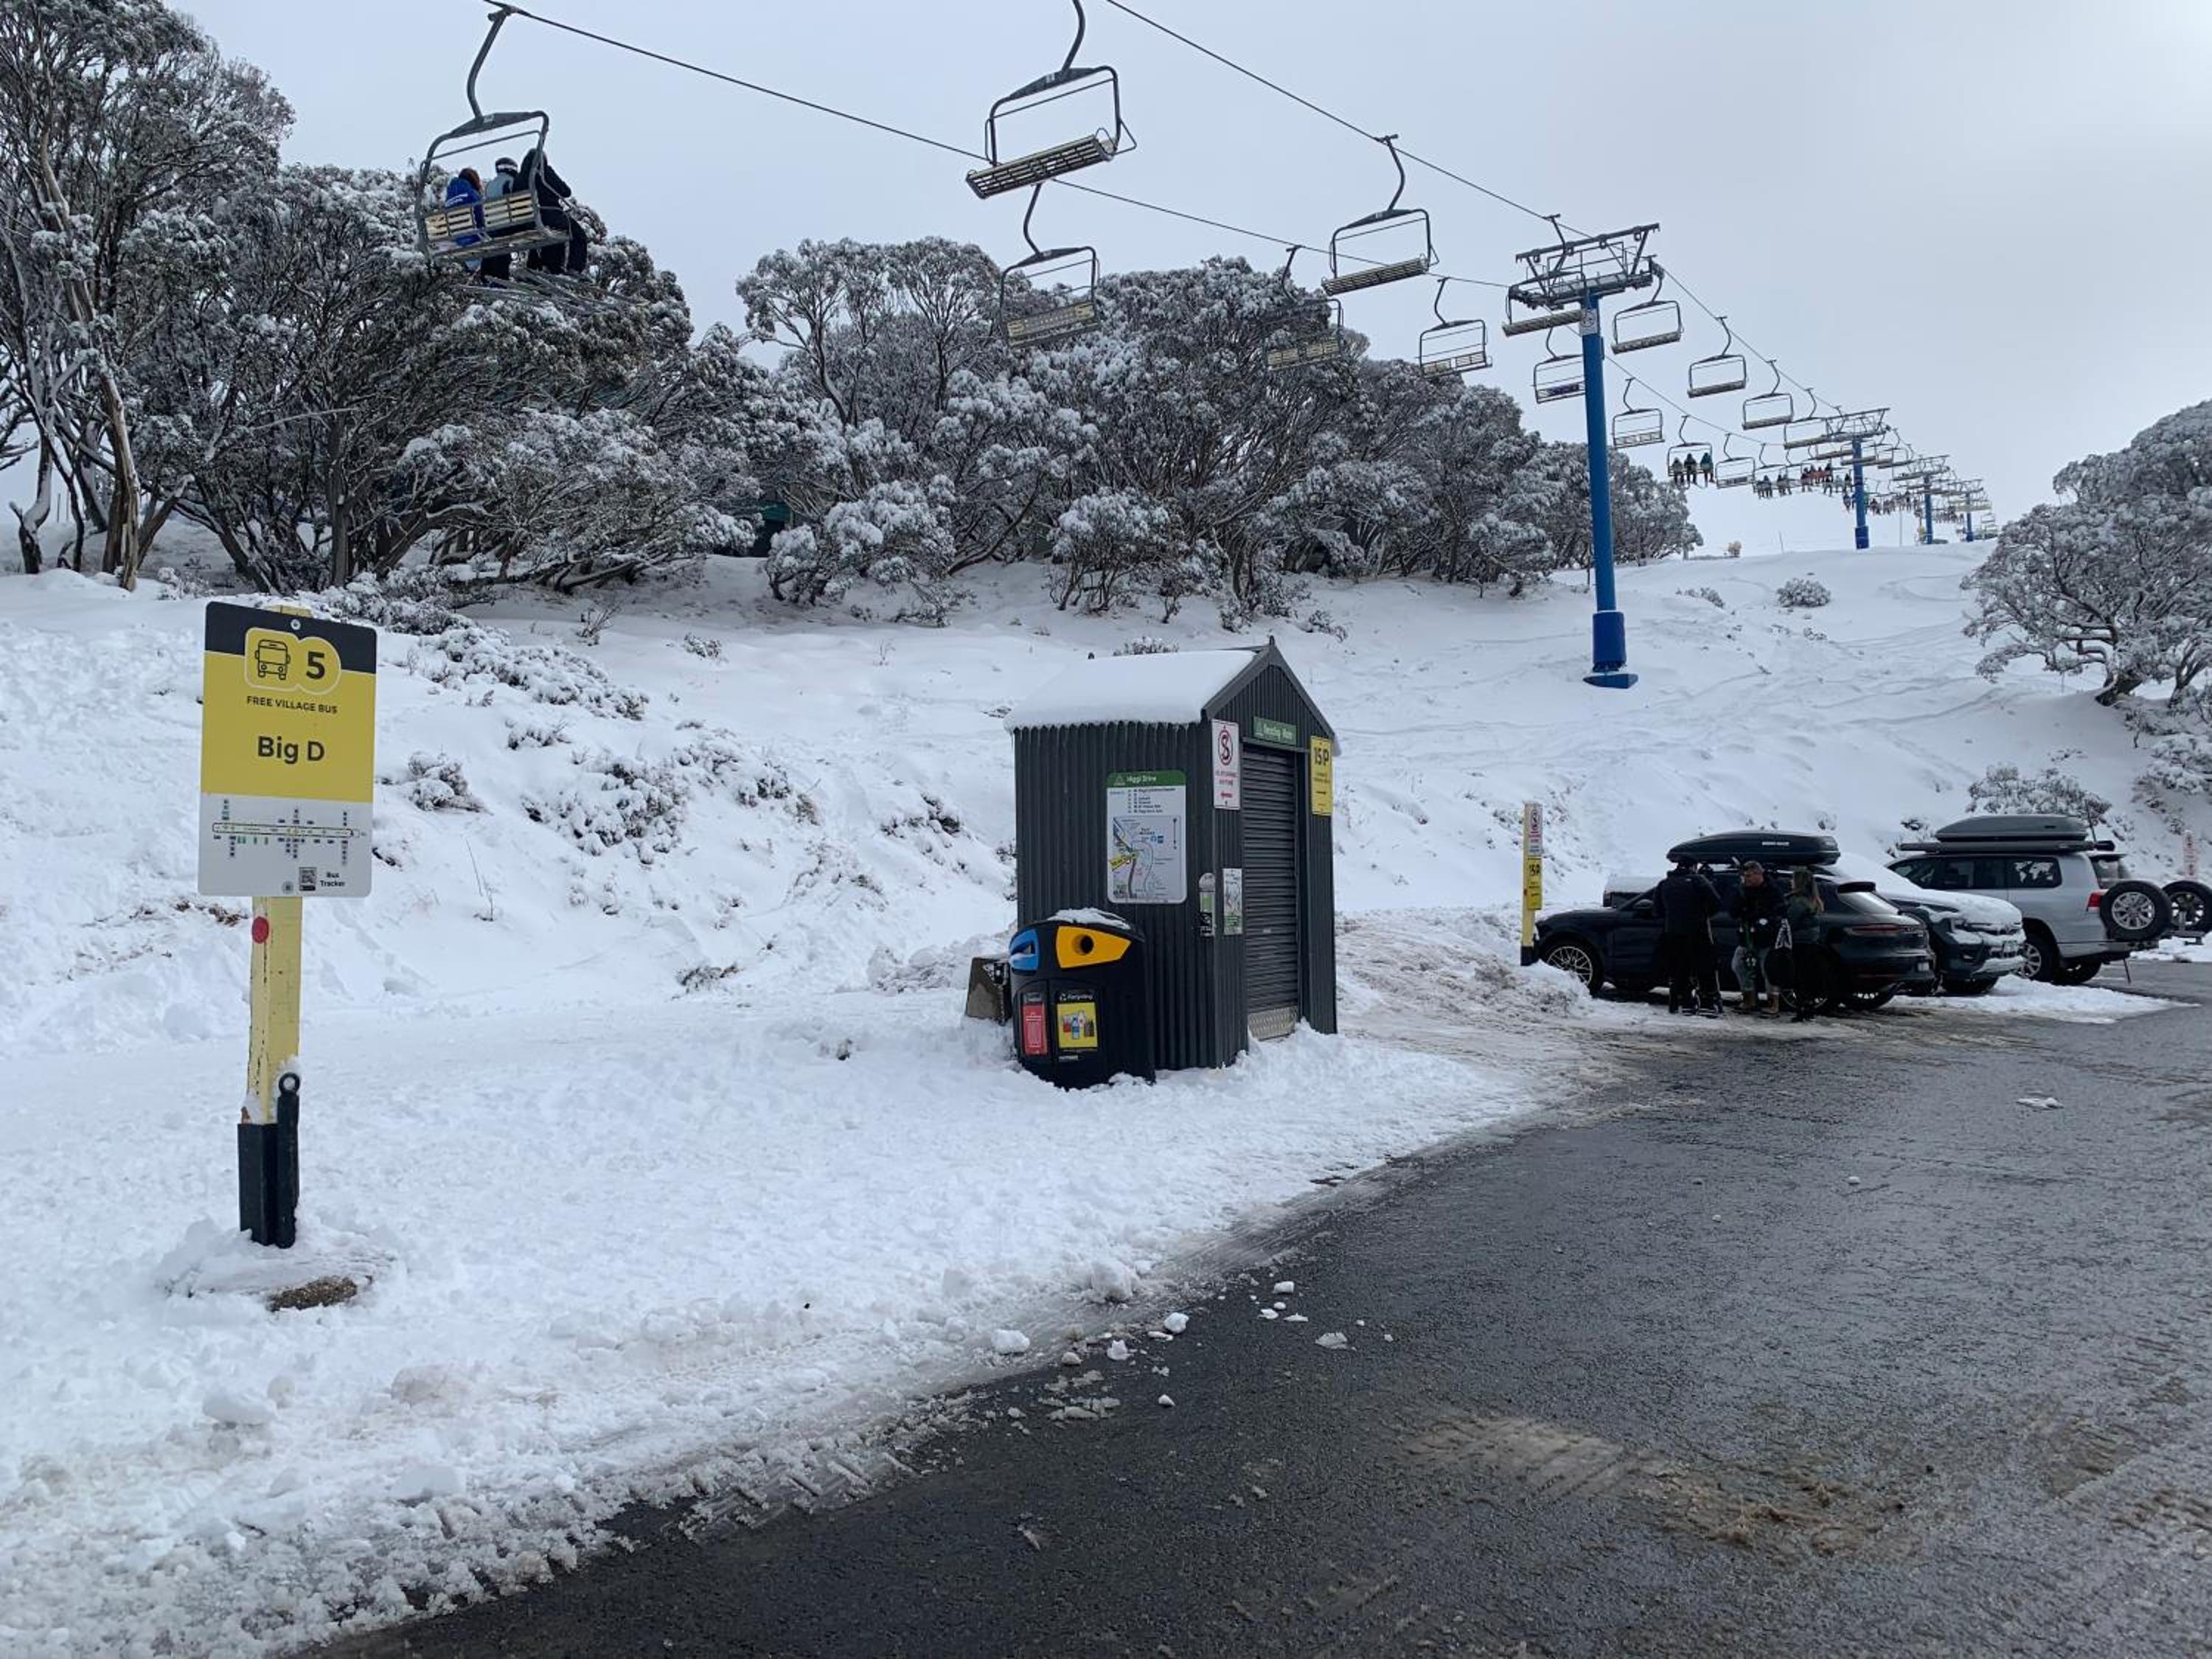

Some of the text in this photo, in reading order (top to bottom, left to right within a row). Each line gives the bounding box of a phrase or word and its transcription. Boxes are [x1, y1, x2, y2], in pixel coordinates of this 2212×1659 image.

[306, 651, 326, 680] 5
[246, 695, 338, 714] FREE VILLAGE BUS
[257, 736, 325, 765] Big D
